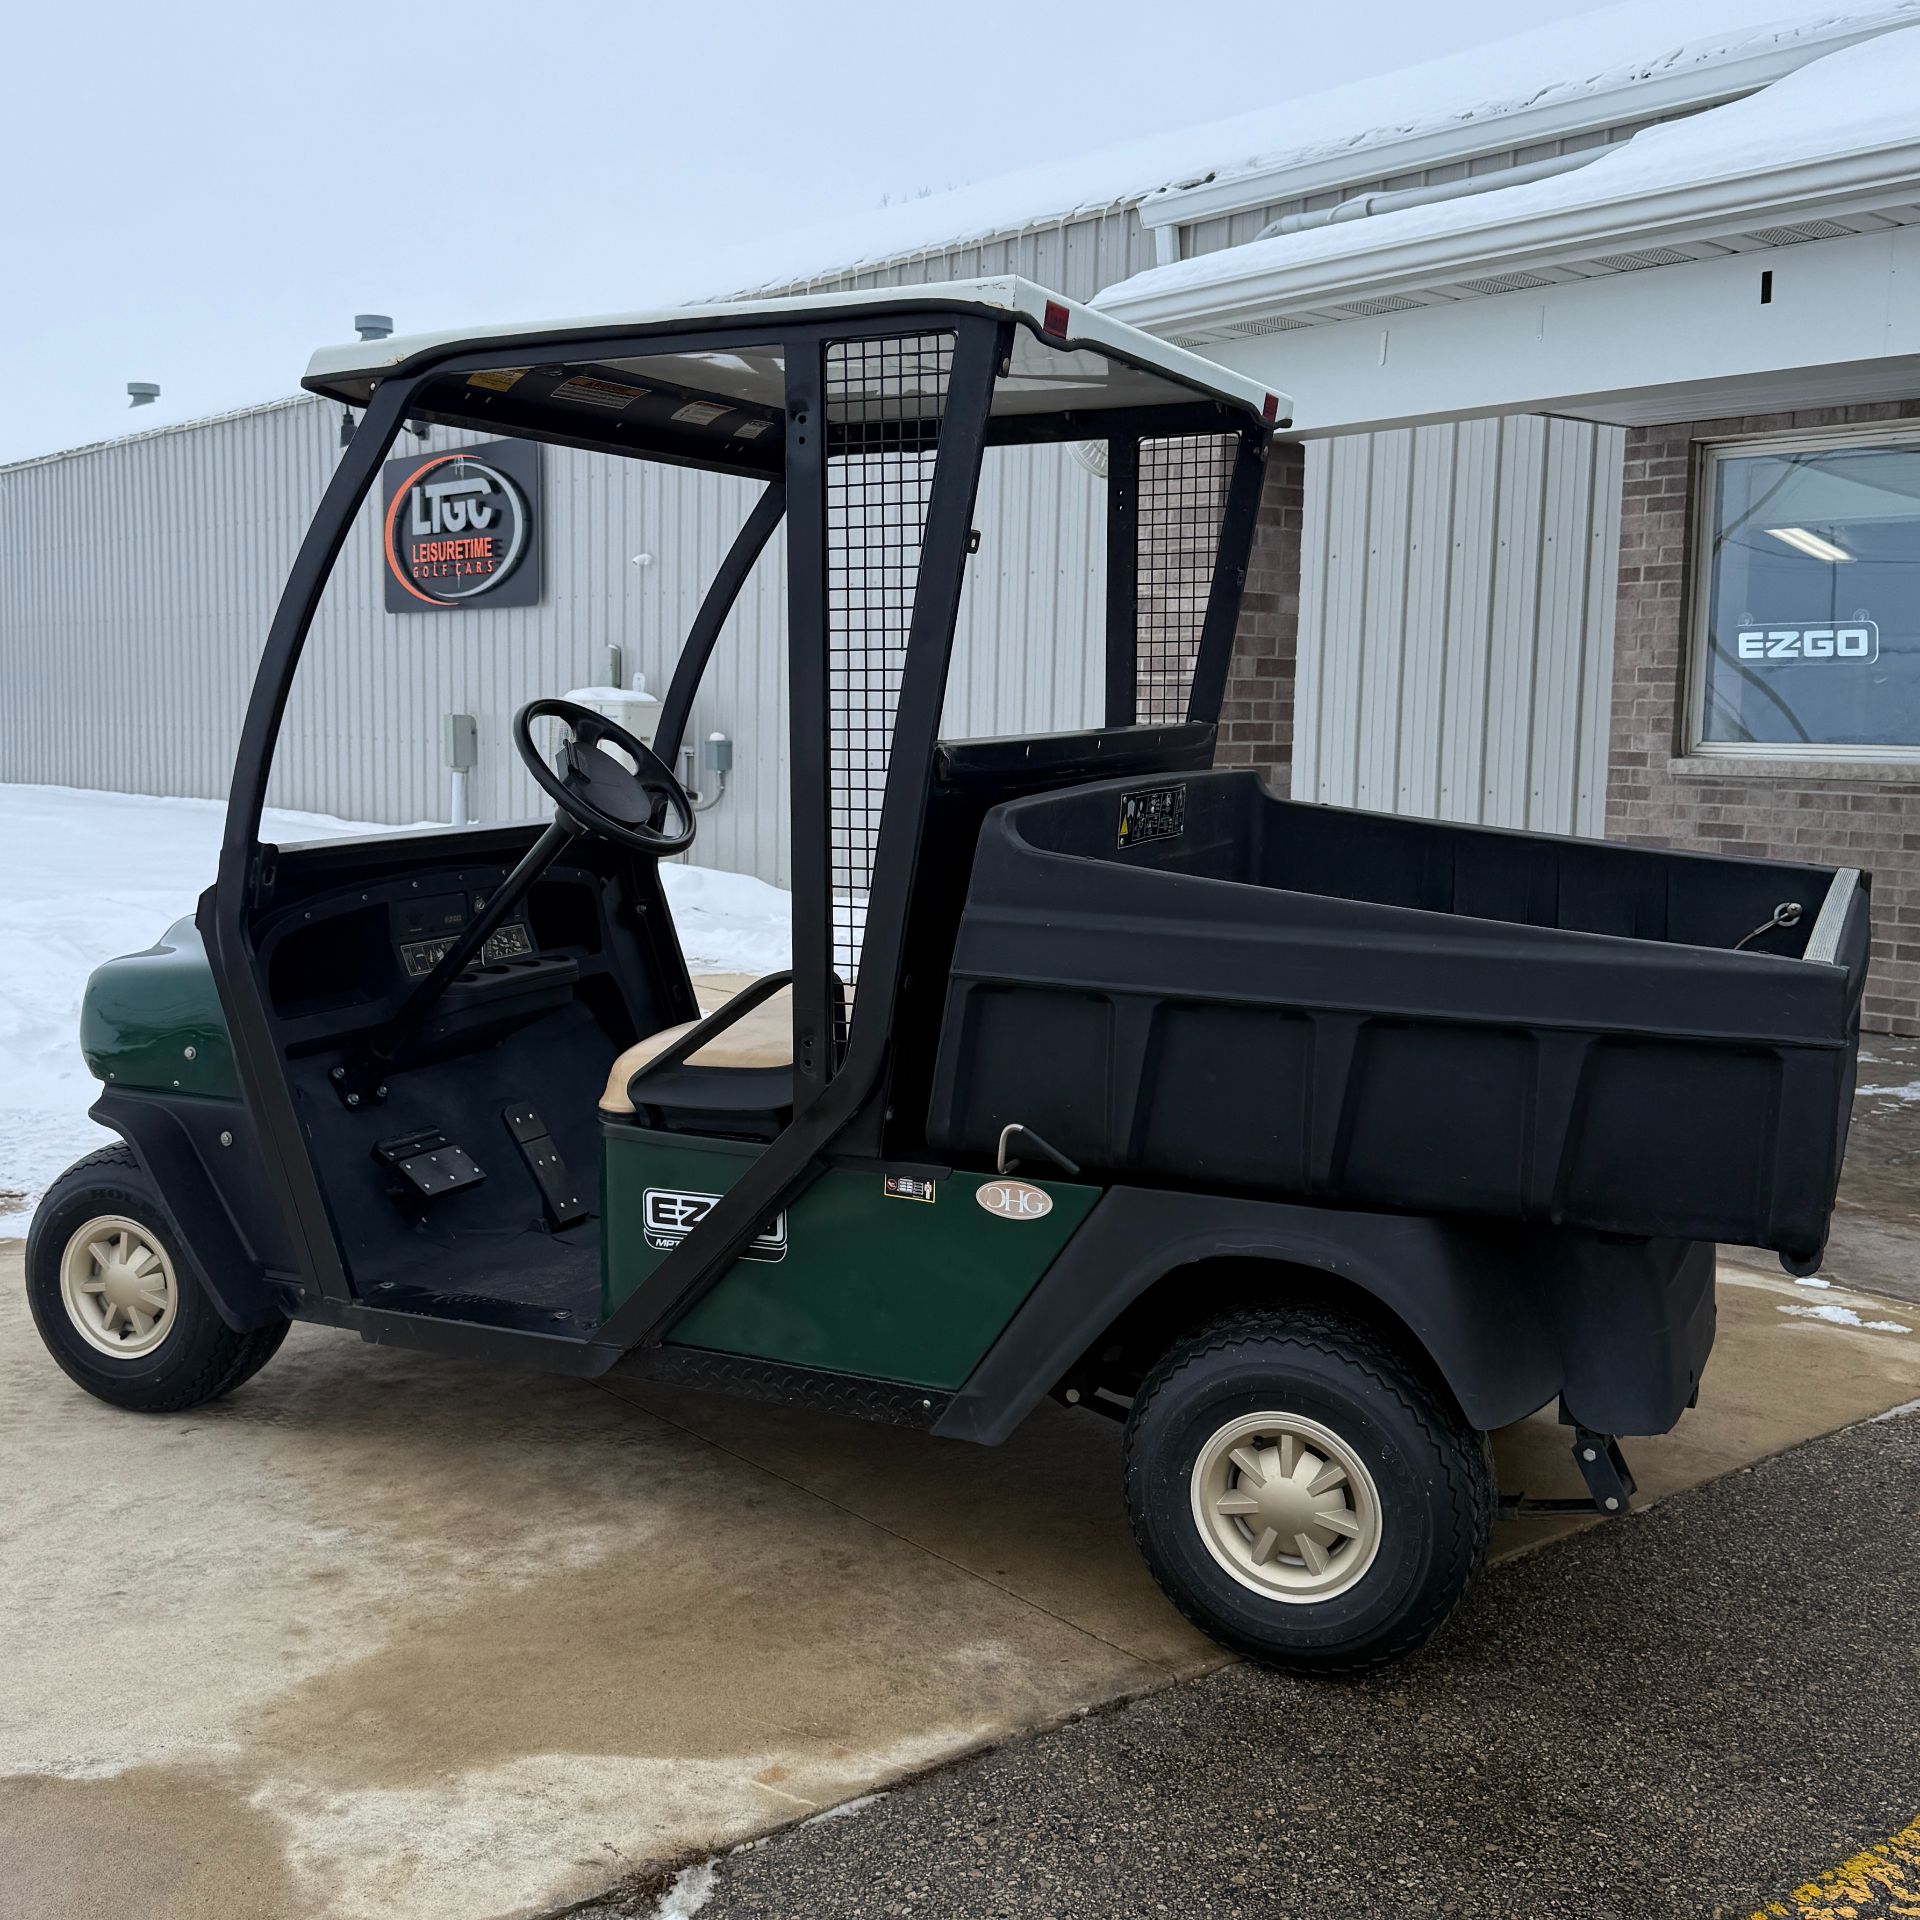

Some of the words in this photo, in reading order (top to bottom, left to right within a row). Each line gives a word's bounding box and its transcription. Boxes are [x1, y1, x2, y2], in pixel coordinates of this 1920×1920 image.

[412, 478, 492, 535] LTGC
[412, 537, 493, 563] LEISURETIME
[413, 564, 448, 578] GOLF
[455, 561, 493, 577] CARS
[1738, 629, 1868, 659] EZGO
